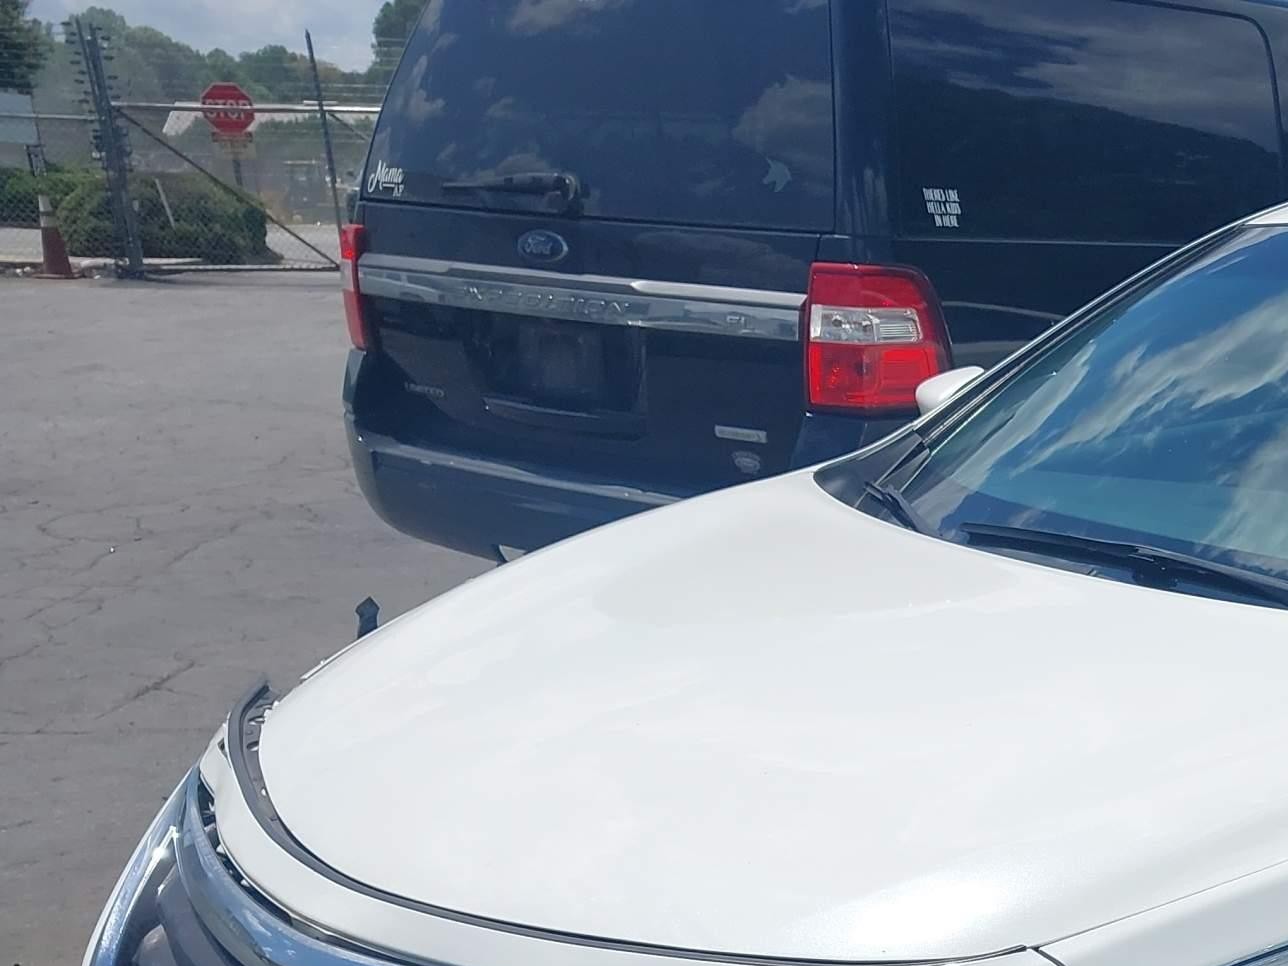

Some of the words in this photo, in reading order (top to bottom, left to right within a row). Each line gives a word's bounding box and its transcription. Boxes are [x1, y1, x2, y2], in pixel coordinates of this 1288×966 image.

[206, 99, 249, 119] STOP
[368, 159, 404, 193] Mama
[934, 214, 943, 227] IN
[524, 236, 553, 255] Ford
